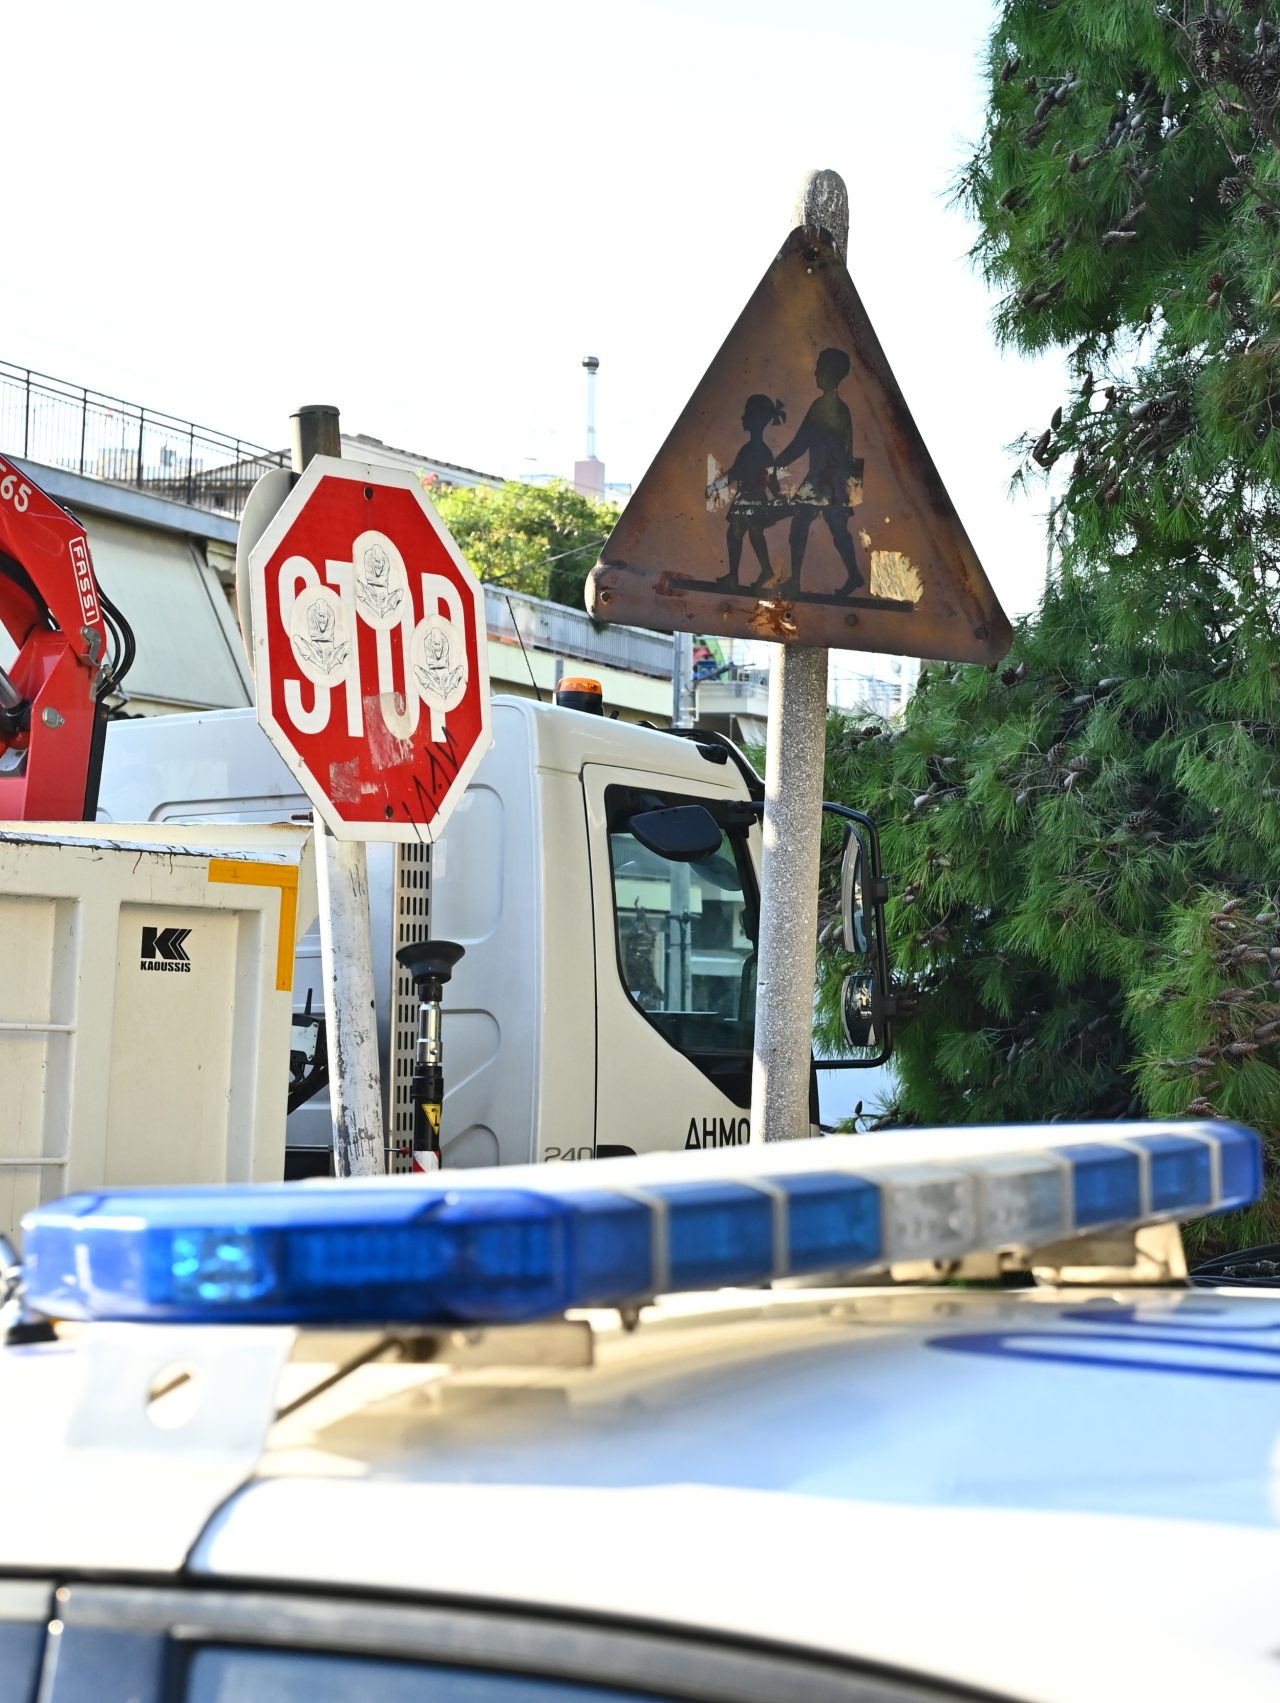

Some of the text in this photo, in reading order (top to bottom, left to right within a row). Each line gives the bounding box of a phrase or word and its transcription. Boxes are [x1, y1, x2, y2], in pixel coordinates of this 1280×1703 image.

[0, 463, 32, 513] 65
[73, 545, 96, 617] FASSI
[140, 960, 191, 973] KAOUSSIS
[685, 1117, 751, 1150] ΔΗΜΟ
